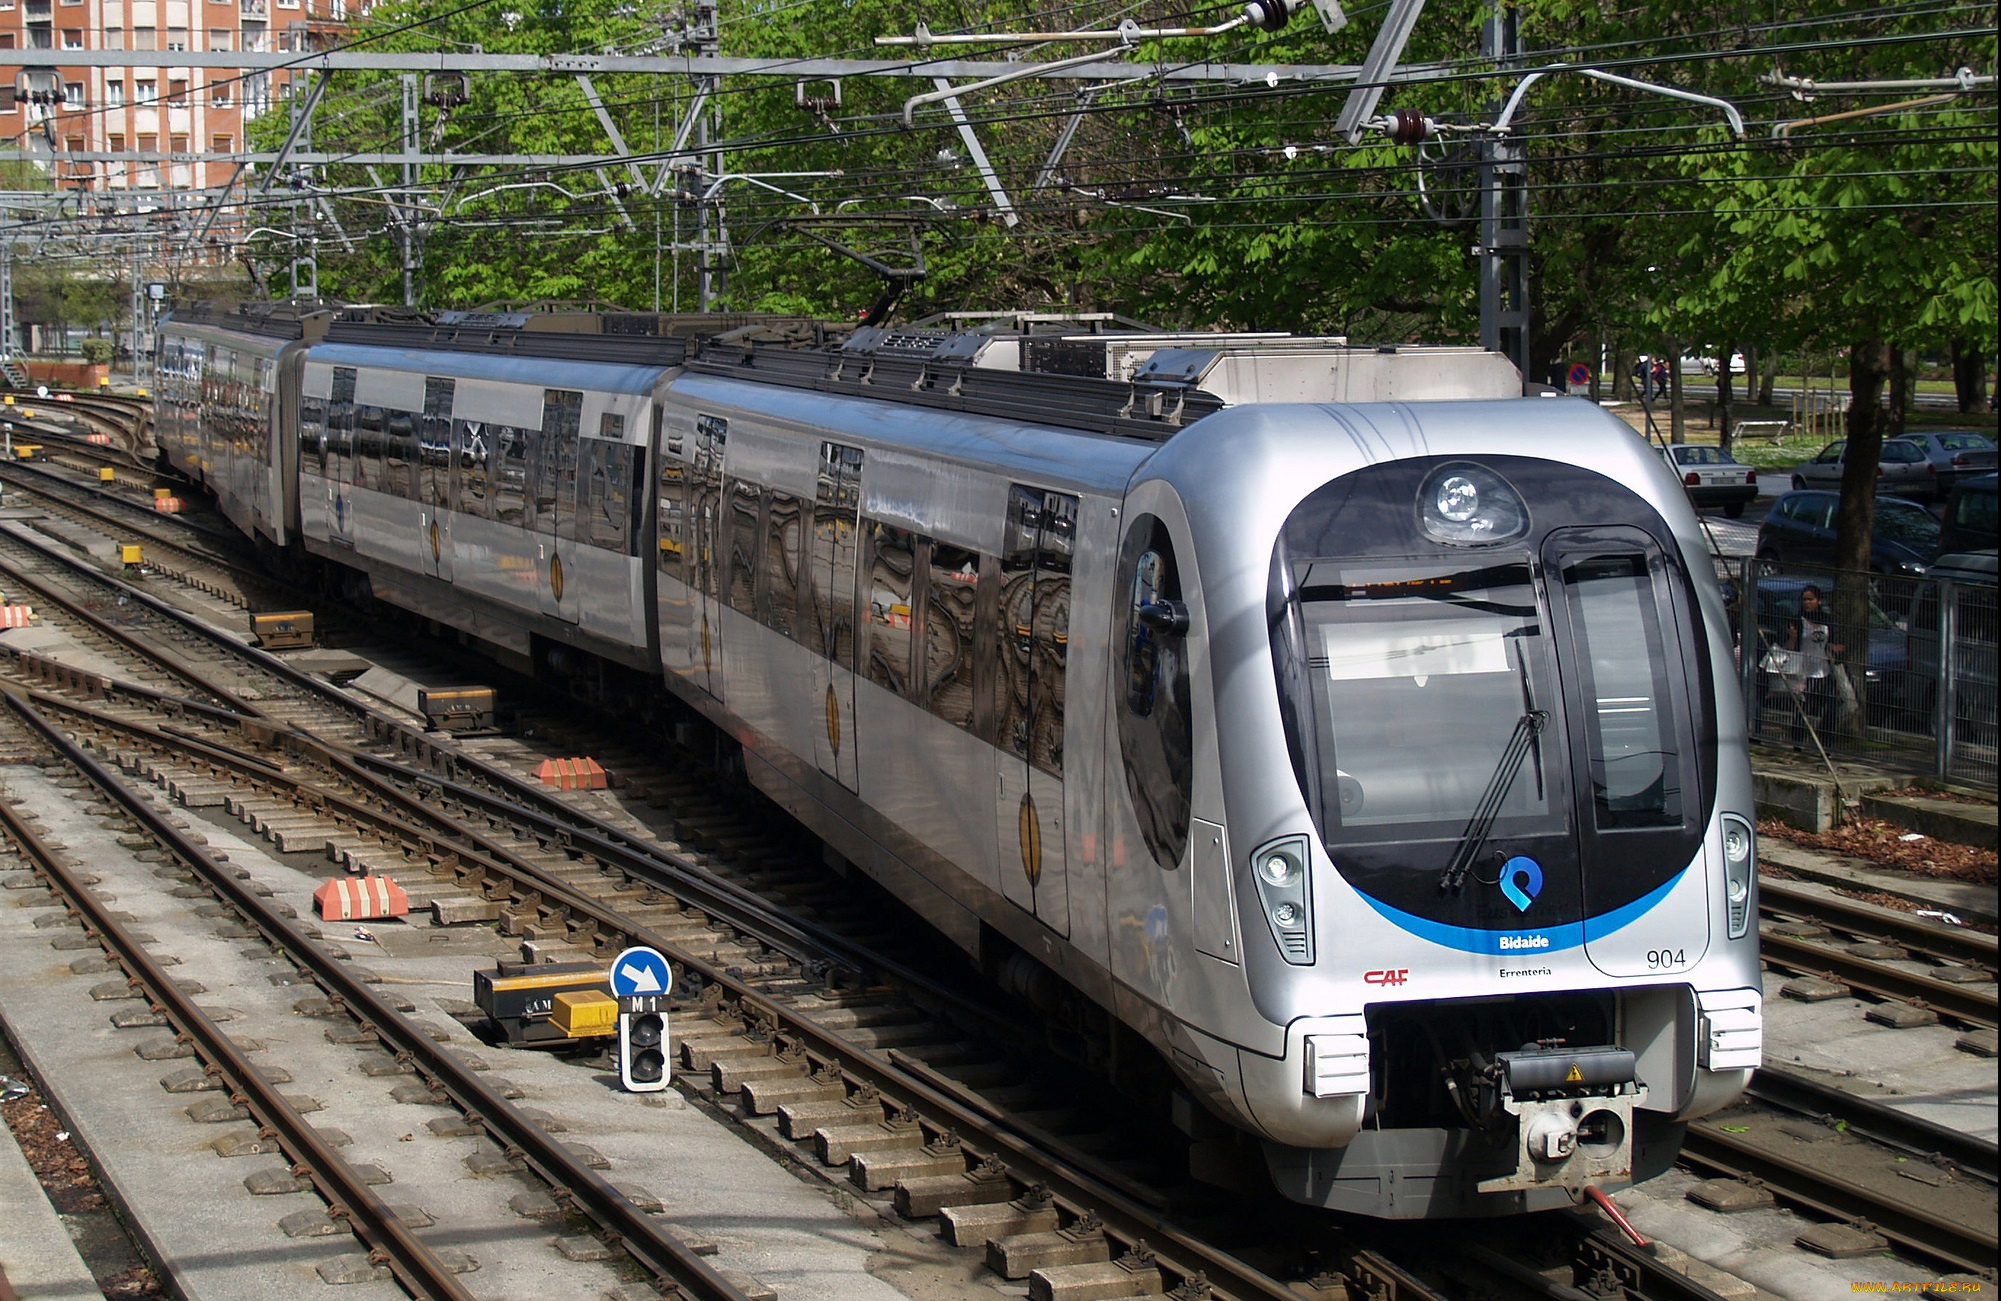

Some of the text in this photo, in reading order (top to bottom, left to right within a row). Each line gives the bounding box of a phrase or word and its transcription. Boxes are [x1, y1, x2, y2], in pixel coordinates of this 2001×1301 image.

[1499, 934, 1550, 950] Bidaide
[1647, 948, 1686, 970] 904
[1364, 968, 1409, 987] CAF
[1499, 966, 1552, 978] Errenteria
